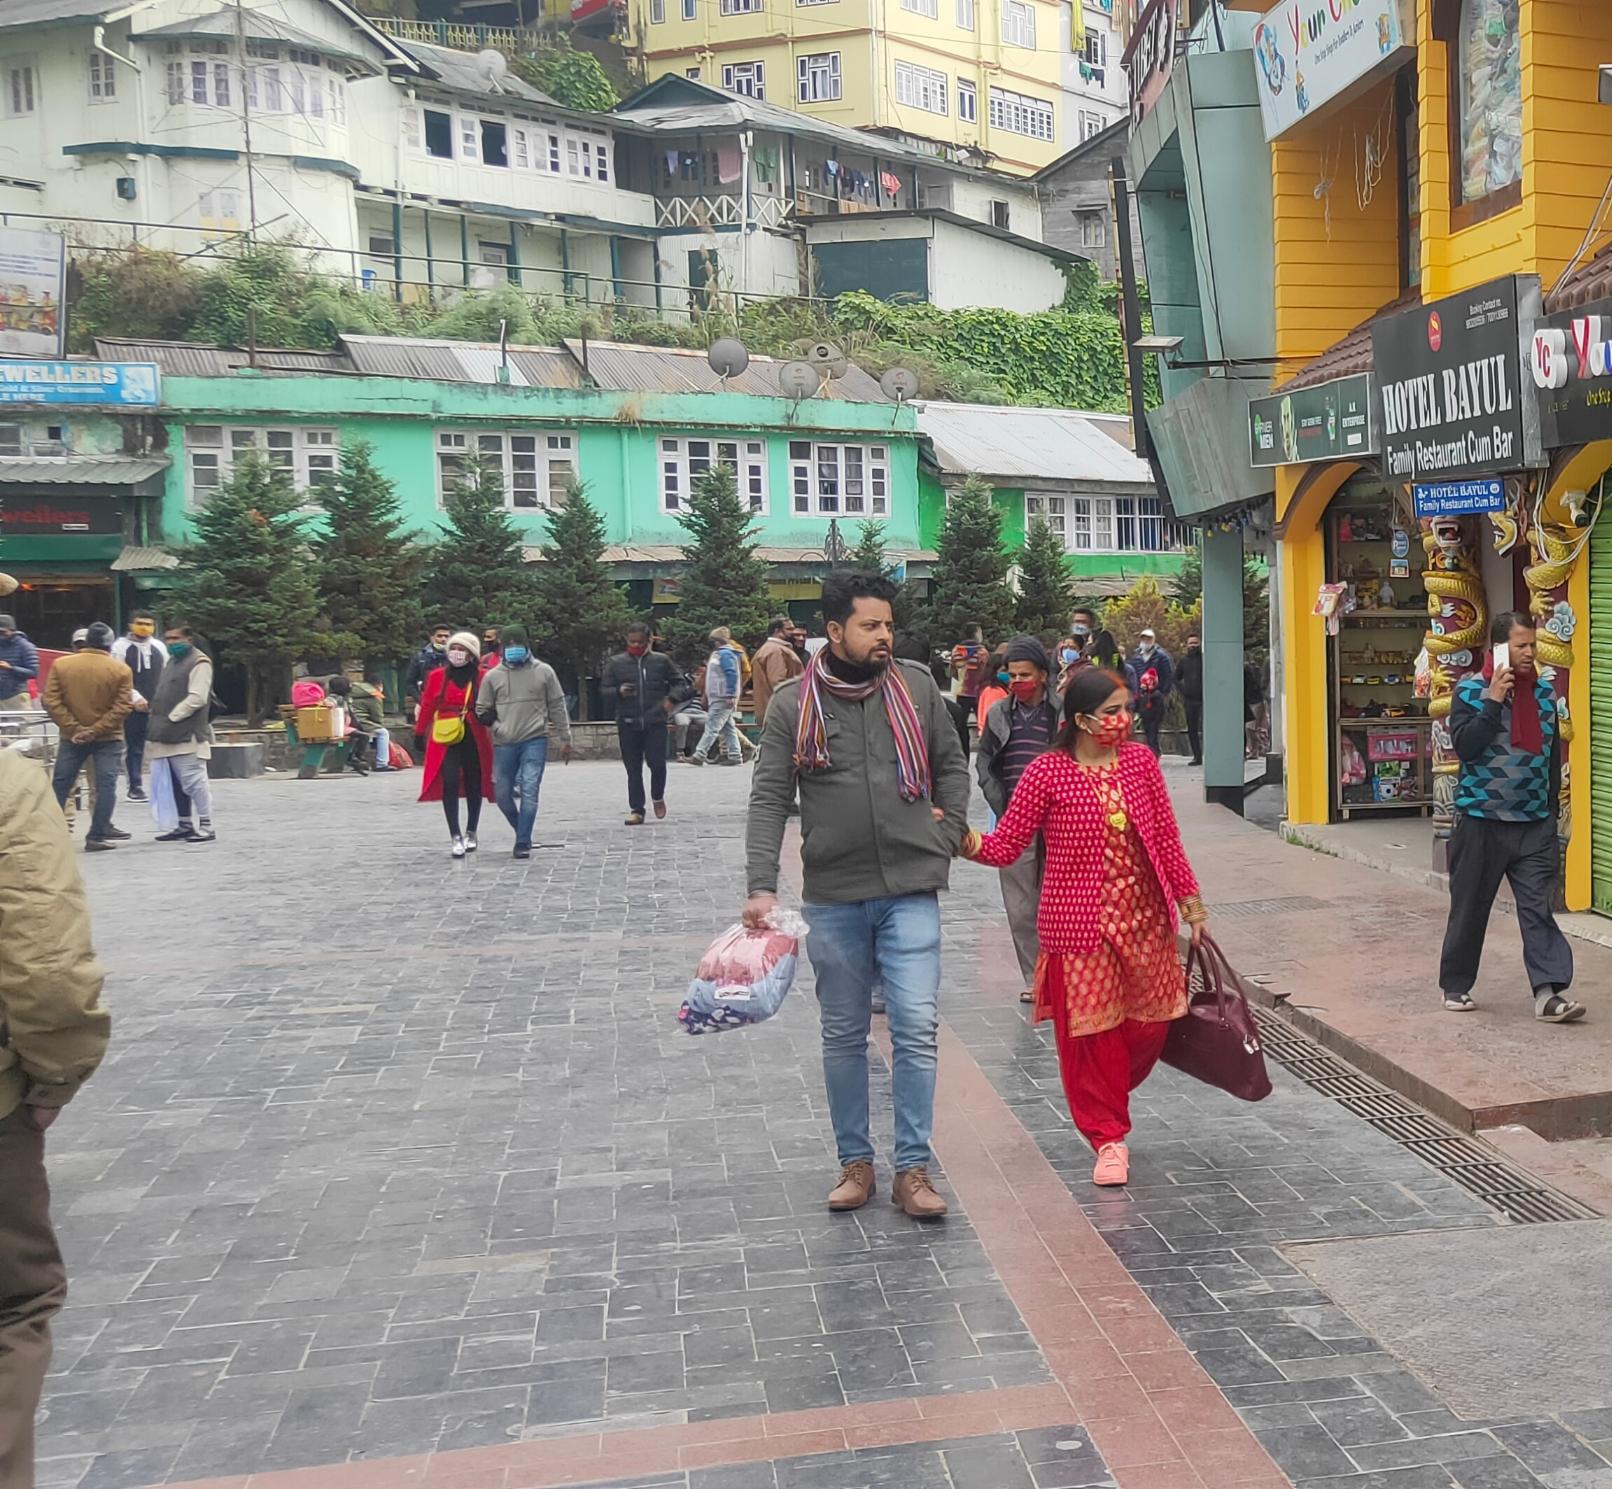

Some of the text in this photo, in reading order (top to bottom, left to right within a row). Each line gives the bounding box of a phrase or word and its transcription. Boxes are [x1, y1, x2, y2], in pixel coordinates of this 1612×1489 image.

[1287, 4, 1326, 56] Your
[1382, 354, 1513, 435] HOTEL BAYUL
[1387, 425, 1513, 480] Family Restaurant Cum Bar
[1419, 496, 1501, 513] Family Restaurant Cum Bar
[1430, 486, 1460, 497] HOTEL
